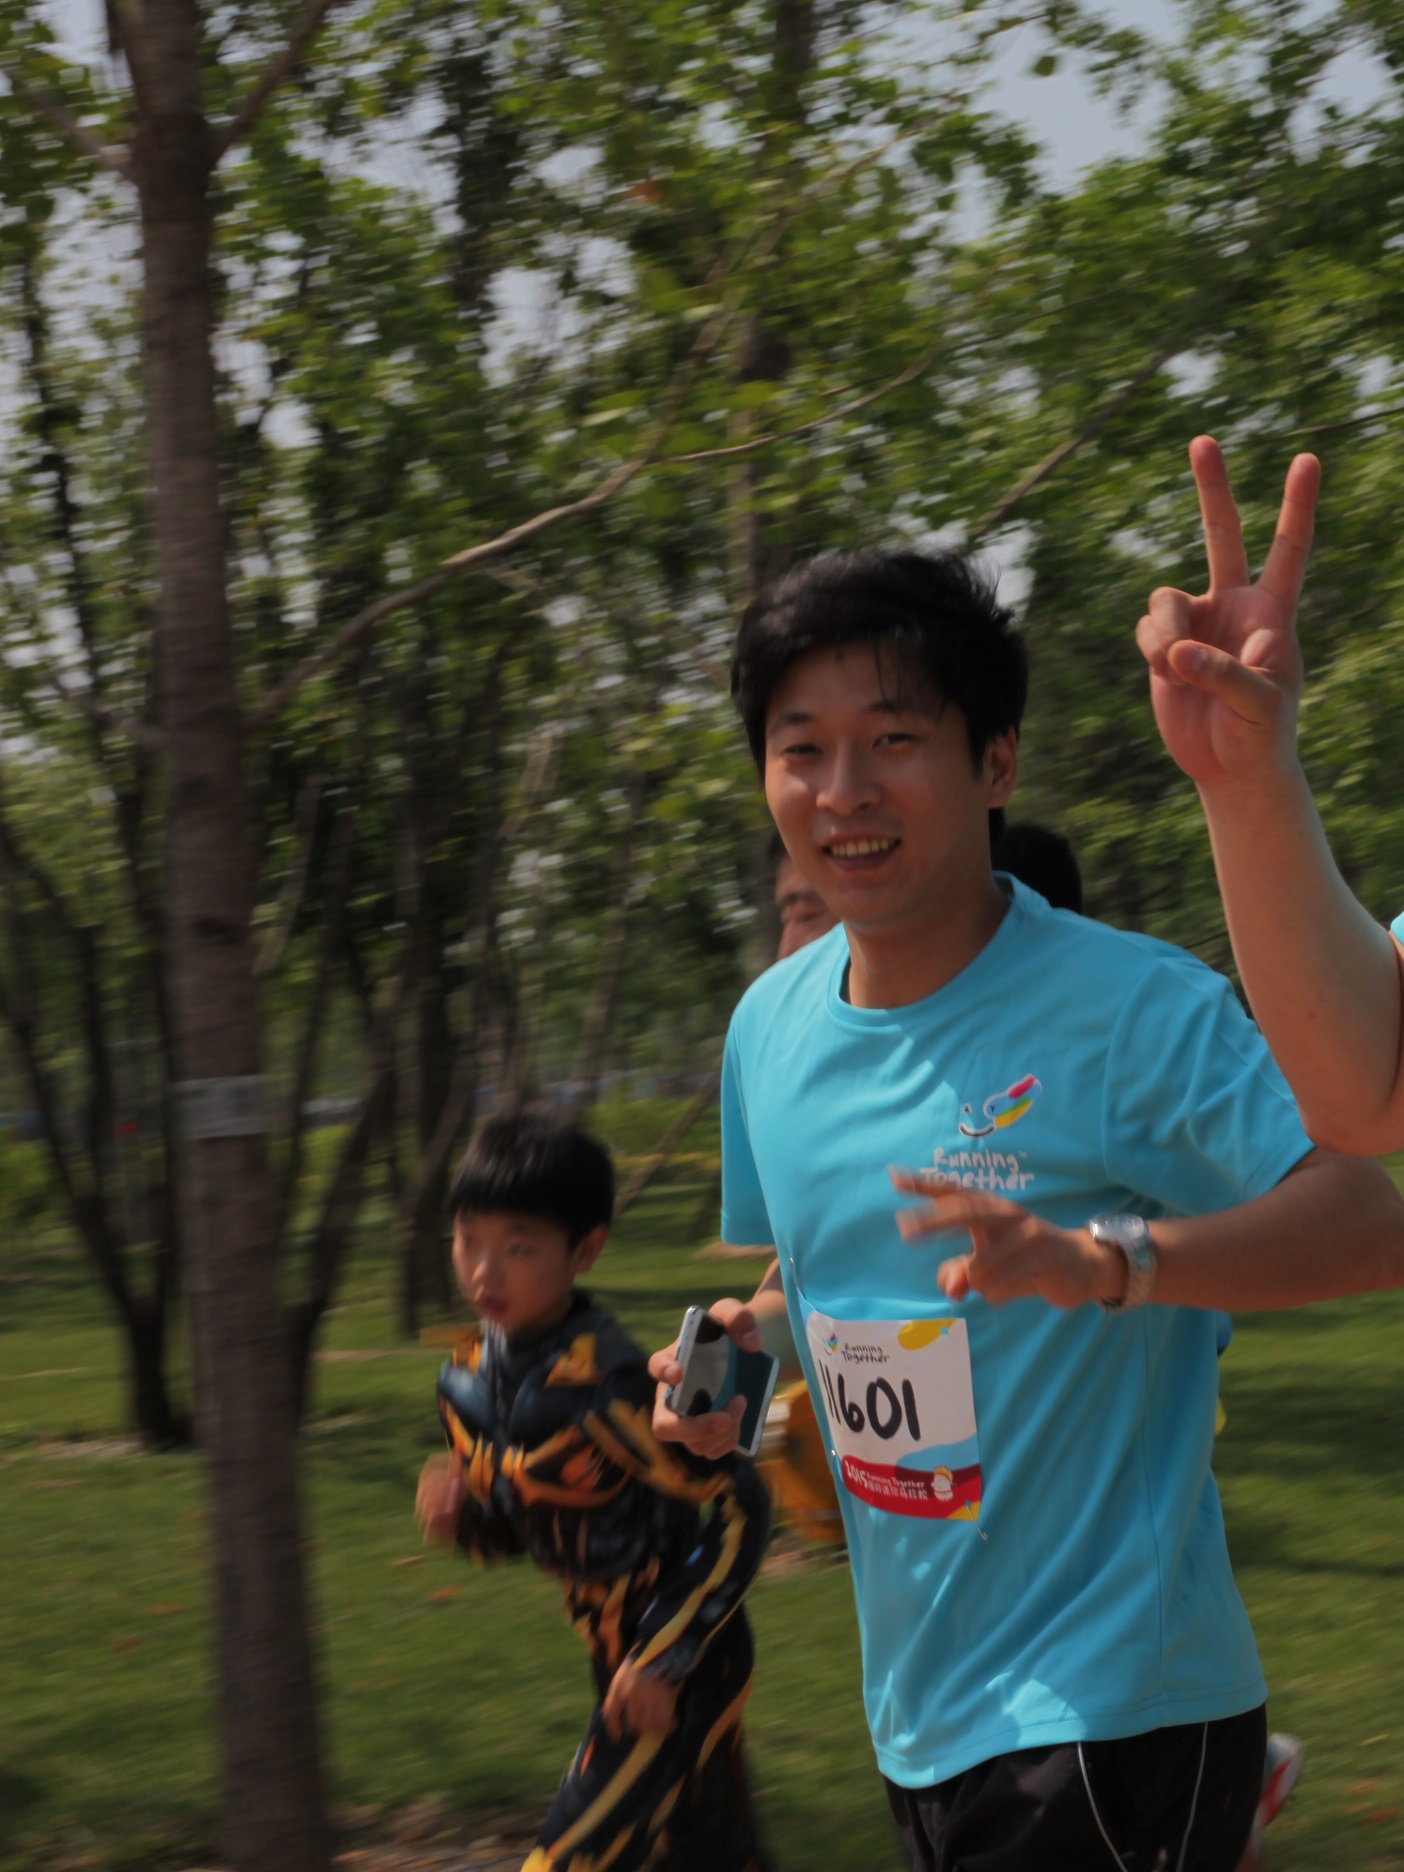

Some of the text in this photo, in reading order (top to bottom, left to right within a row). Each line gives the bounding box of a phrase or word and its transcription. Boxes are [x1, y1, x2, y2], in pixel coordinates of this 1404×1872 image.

[933, 1147, 1019, 1172] Running
[841, 1350, 890, 1365] Together
[844, 1342, 883, 1354] Running
[818, 1359, 921, 1442] 11601
[844, 1460, 868, 1489] 2015
